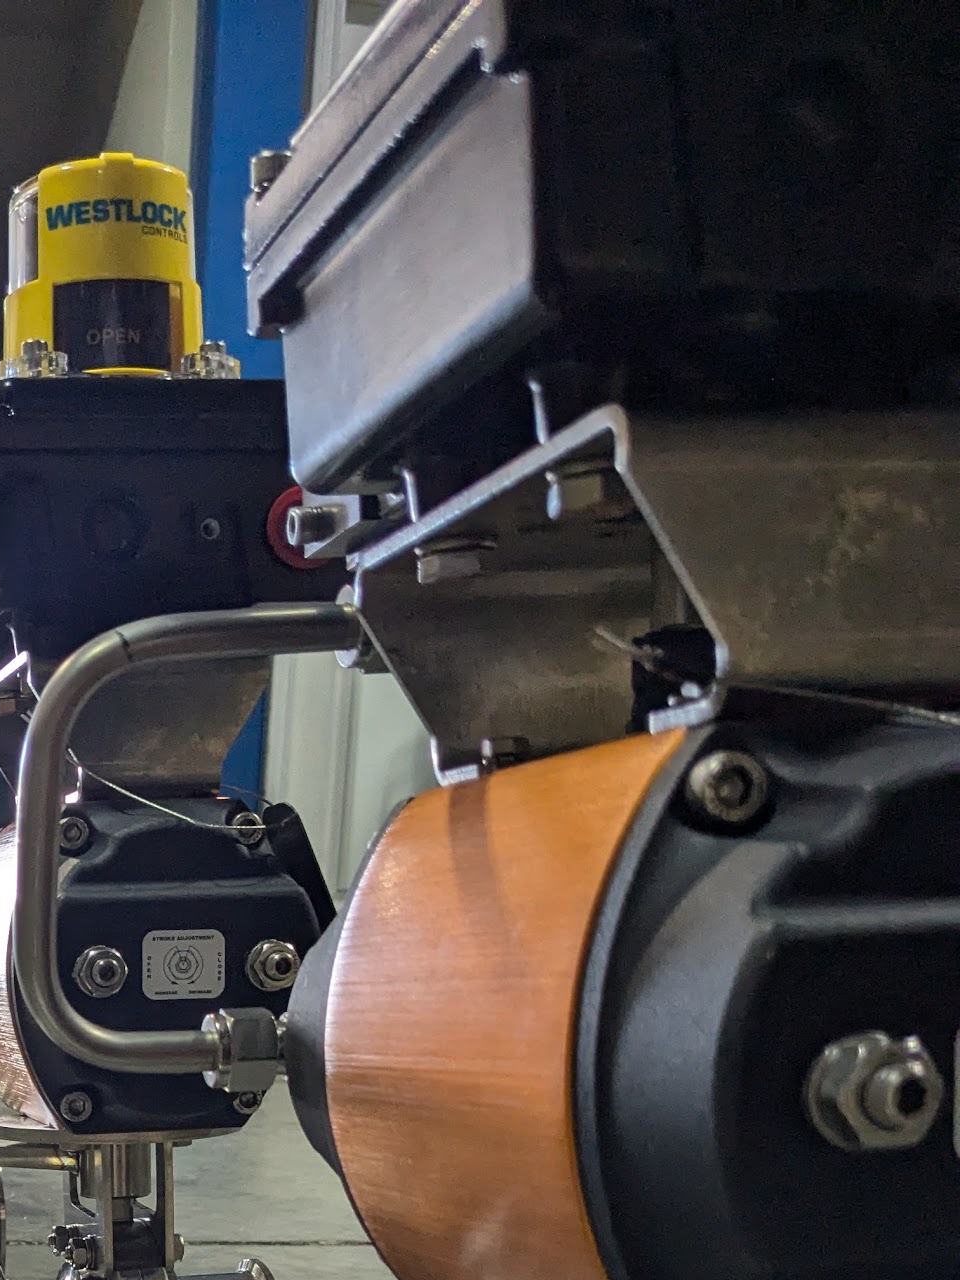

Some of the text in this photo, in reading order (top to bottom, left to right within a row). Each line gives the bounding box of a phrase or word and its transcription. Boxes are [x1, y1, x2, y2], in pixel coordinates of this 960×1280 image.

[46, 198, 187, 232] WESTLOCK
[142, 225, 188, 244] CONTROLS
[86, 328, 140, 345] OPEN
